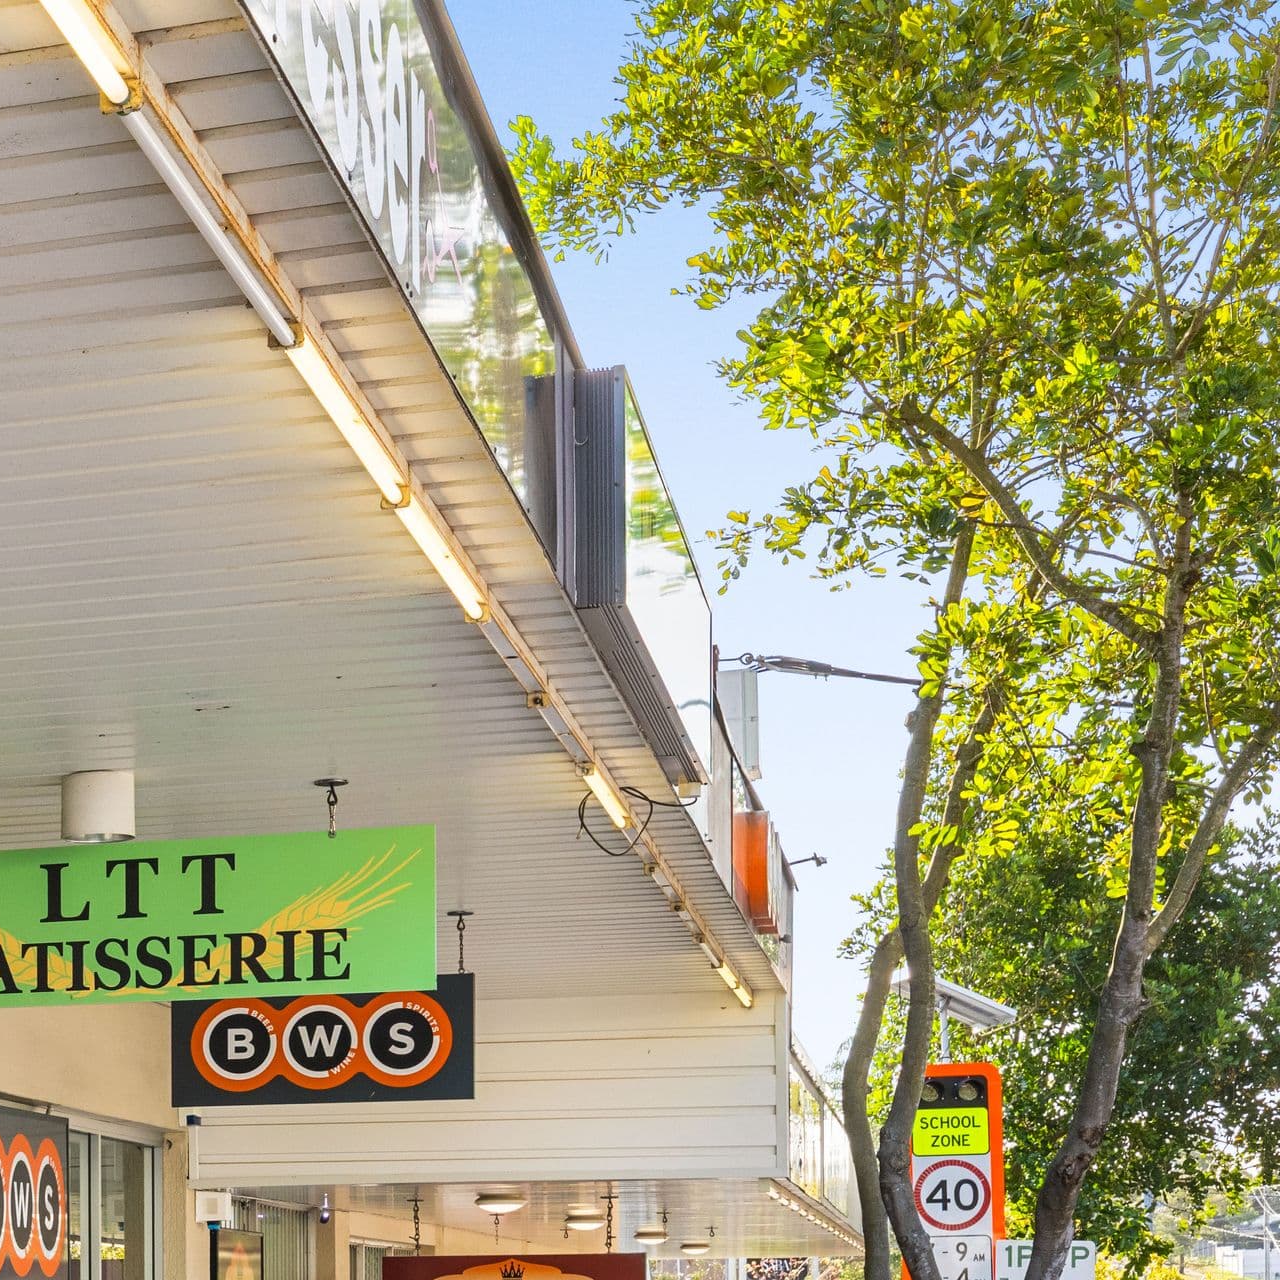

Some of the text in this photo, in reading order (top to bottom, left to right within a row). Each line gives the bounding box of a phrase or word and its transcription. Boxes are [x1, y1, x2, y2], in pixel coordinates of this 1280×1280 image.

[250, 1008, 275, 1034] BEER
[406, 1001, 440, 1034] SPIRITS
[328, 1050, 356, 1076] WINE
[919, 1115, 981, 1130] SCHOOL
[931, 1133, 971, 1148] ZONE
[925, 1179, 980, 1212] 40
[956, 1242, 986, 1262] 9 AM
